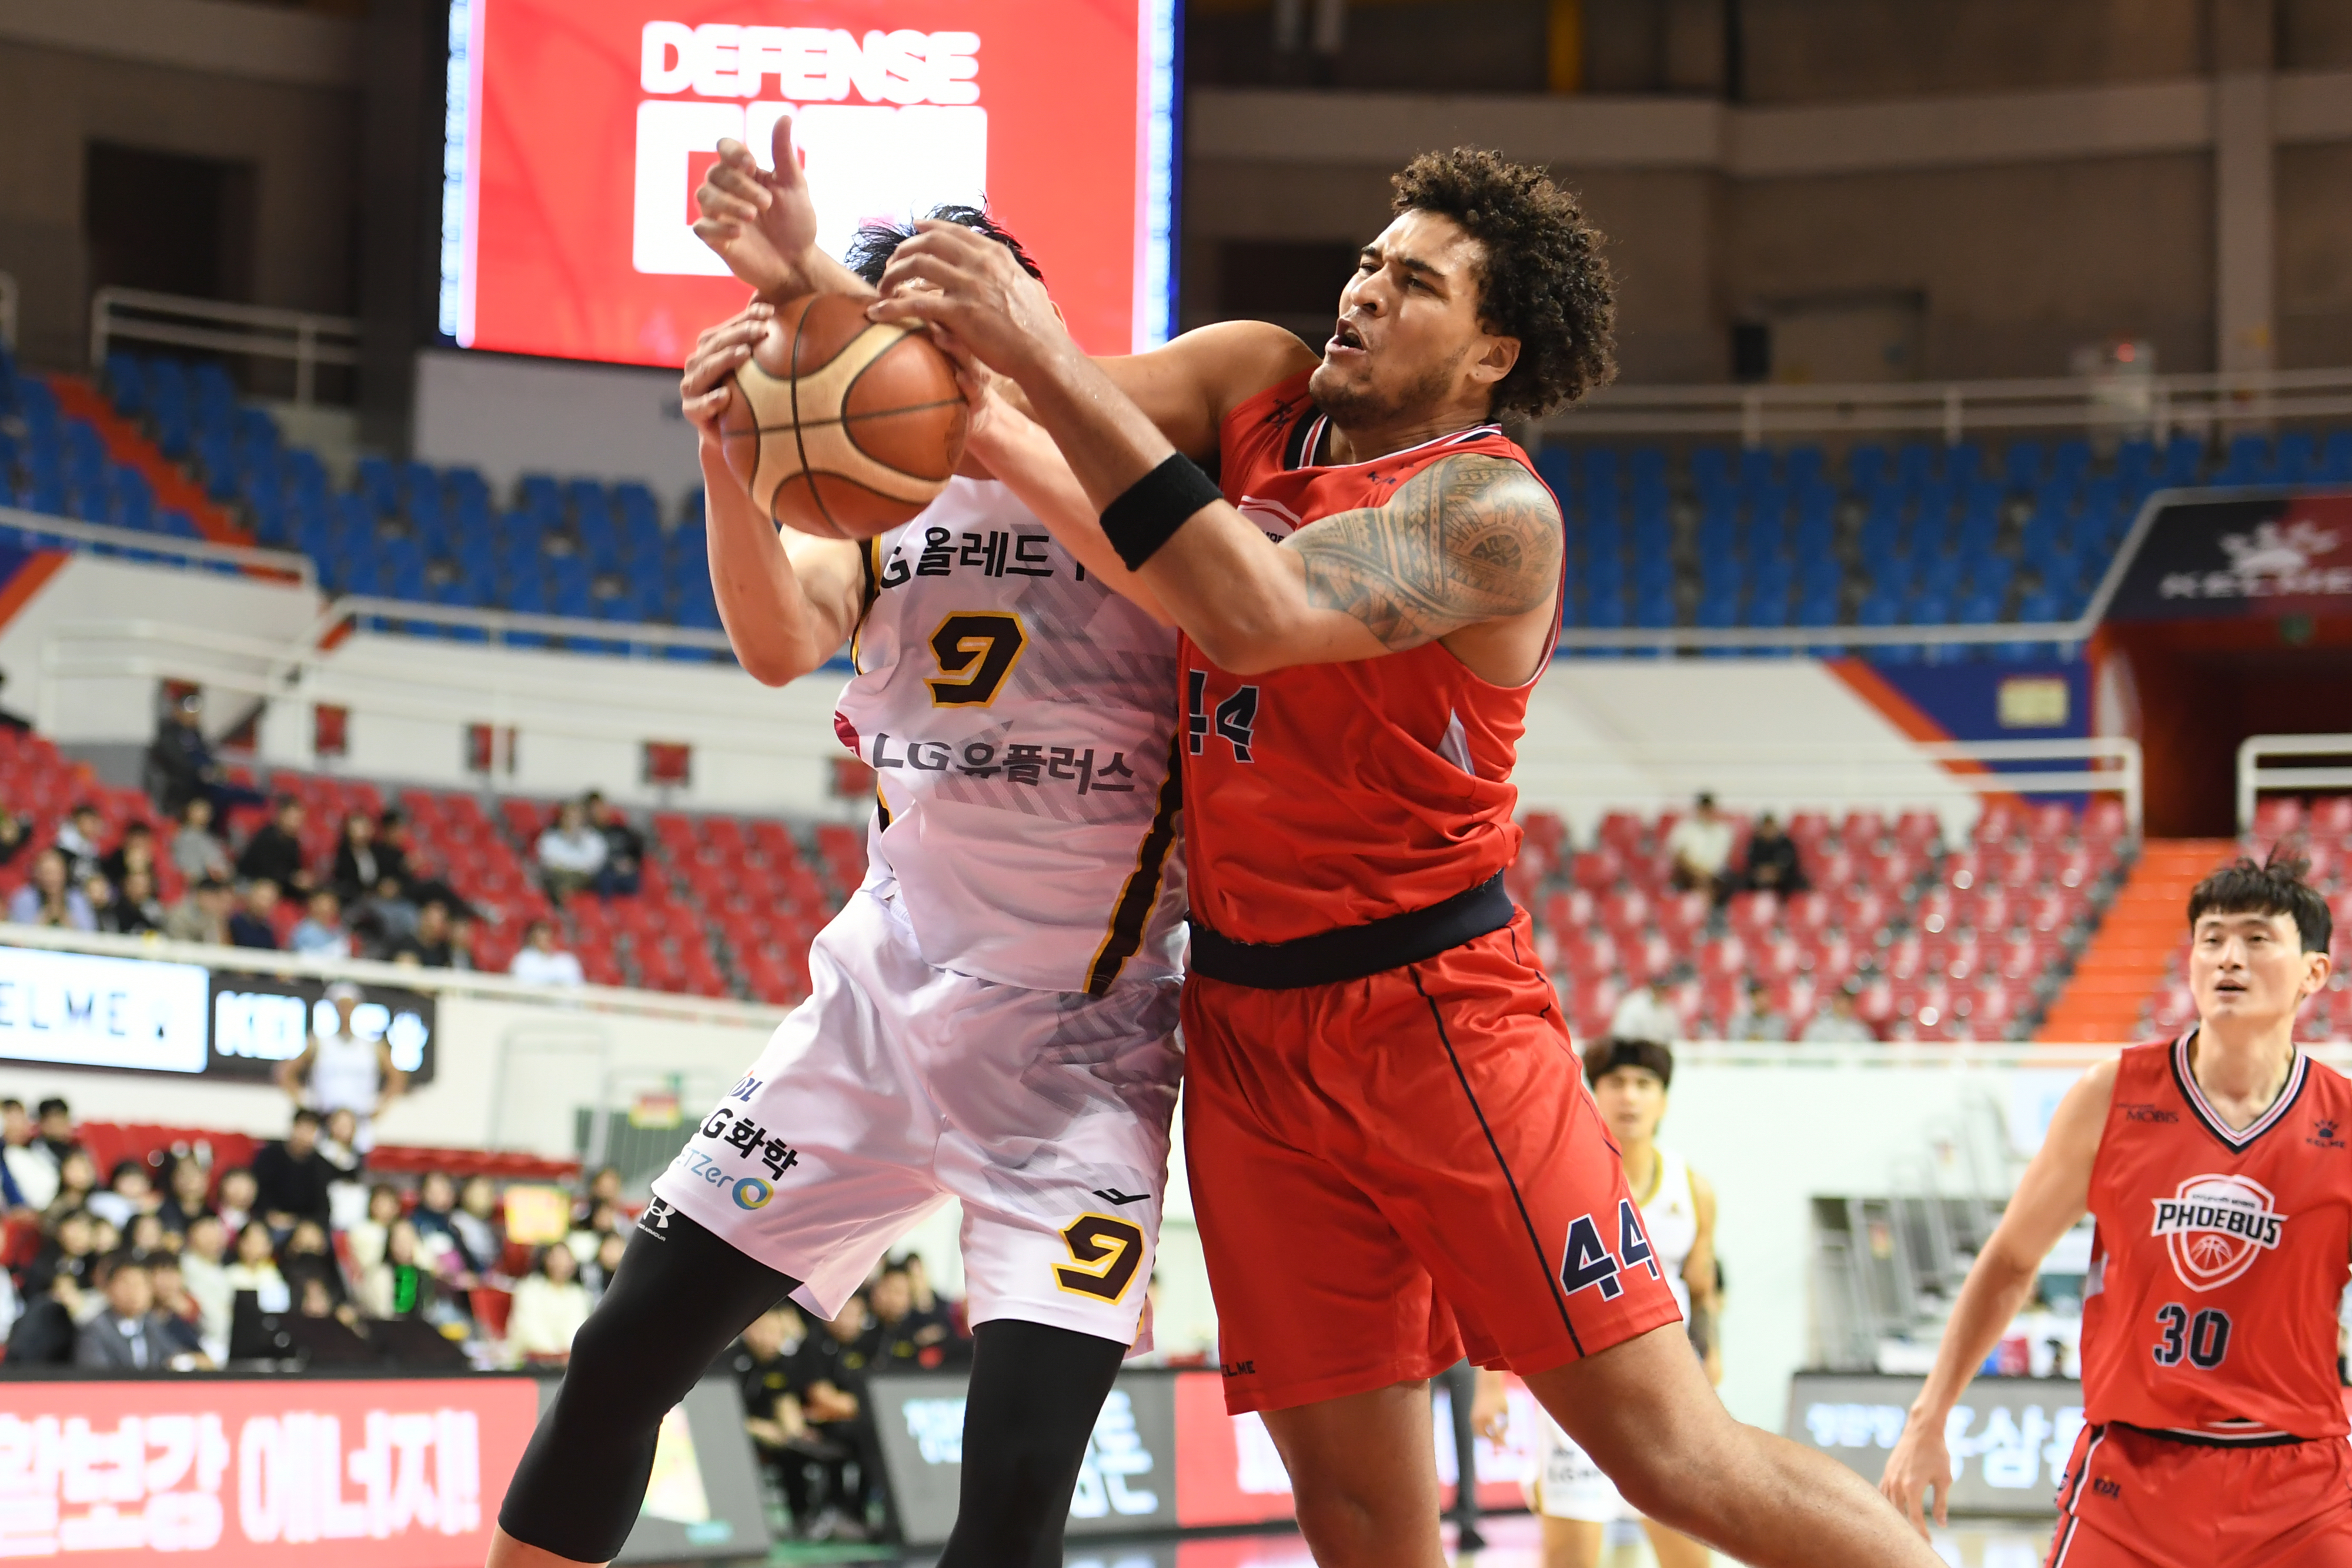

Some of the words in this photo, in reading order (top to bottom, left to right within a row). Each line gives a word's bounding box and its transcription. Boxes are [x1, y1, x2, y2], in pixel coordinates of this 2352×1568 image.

[641, 21, 981, 105] DEFENSE
[923, 611, 1030, 709] 9
[728, 1075, 763, 1102] BL
[699, 1108, 799, 1181] G화학
[1050, 1212, 1144, 1305] 9
[1559, 1198, 1660, 1302] 44
[2157, 1203, 2283, 1245] PHOEBUS
[2152, 1302, 2232, 1370] 30
